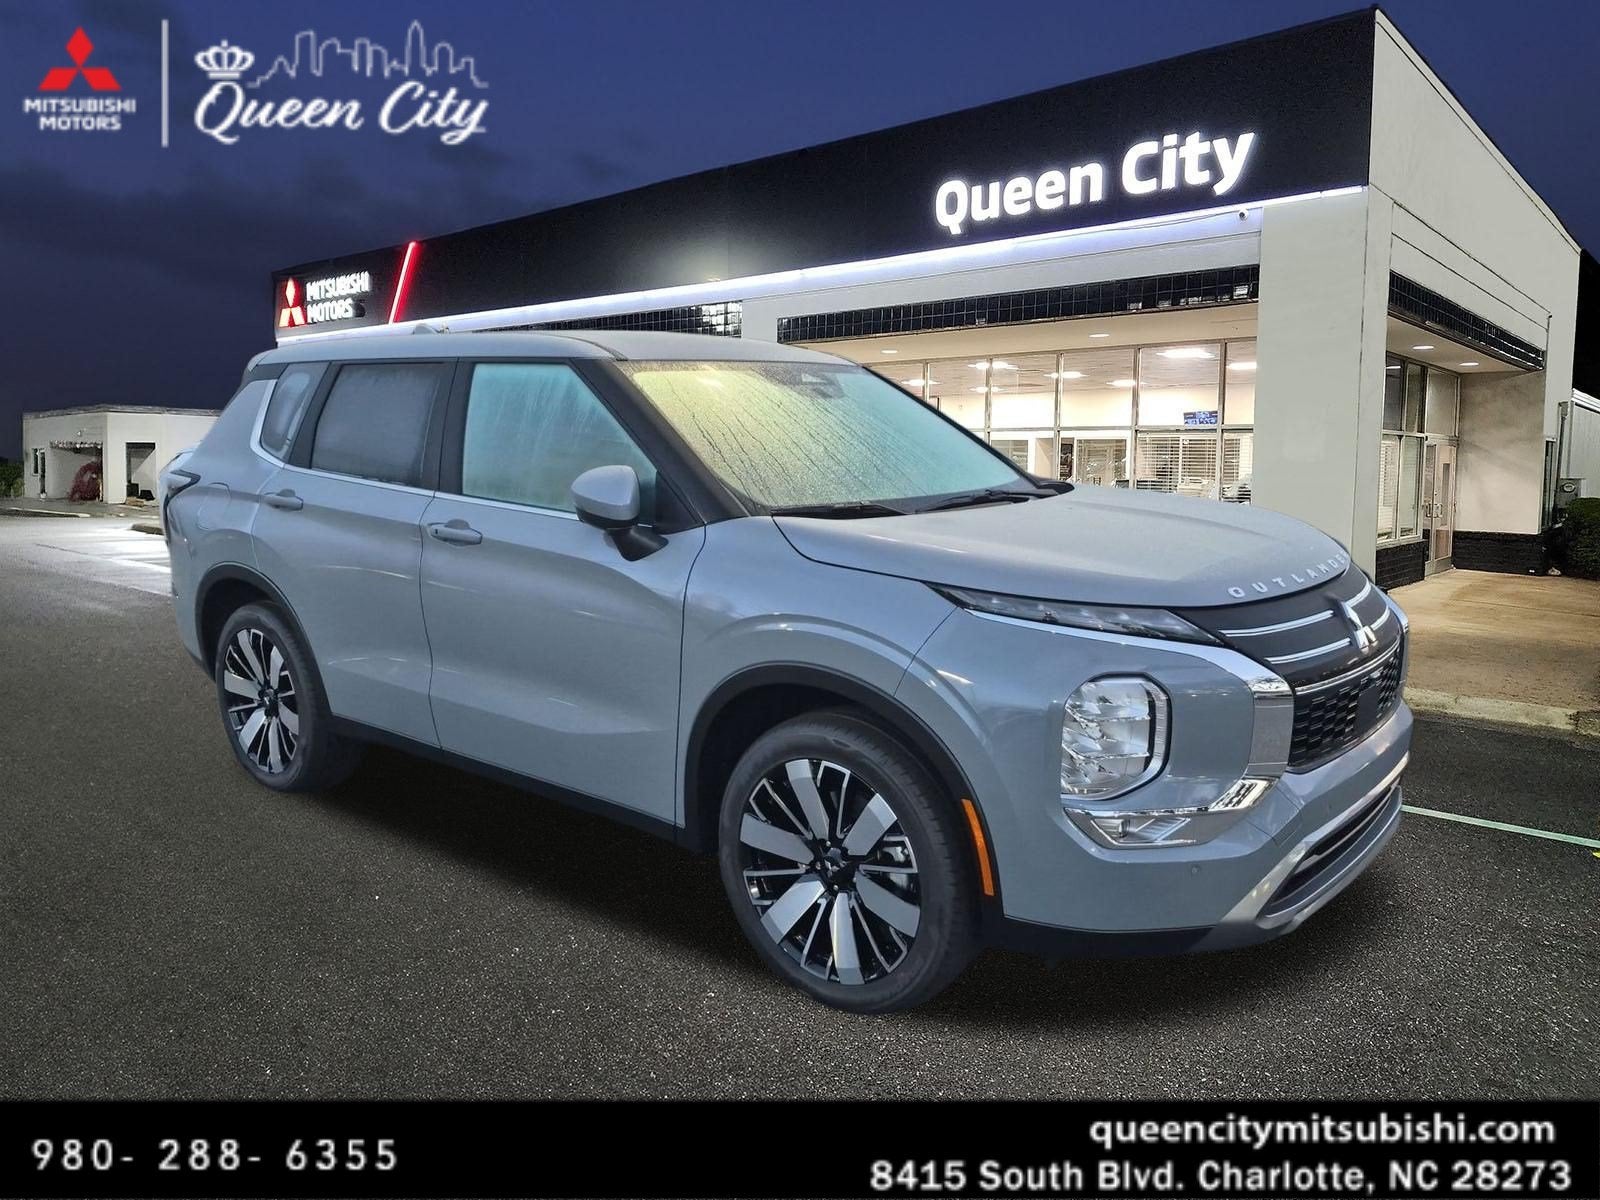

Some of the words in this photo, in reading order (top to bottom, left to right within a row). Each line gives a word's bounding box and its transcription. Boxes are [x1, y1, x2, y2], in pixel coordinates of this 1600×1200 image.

[935, 161, 1104, 234] Queen
[1122, 131, 1256, 195] City
[306, 270, 371, 302] MITSUBISHI
[307, 298, 354, 324] MOTORS
